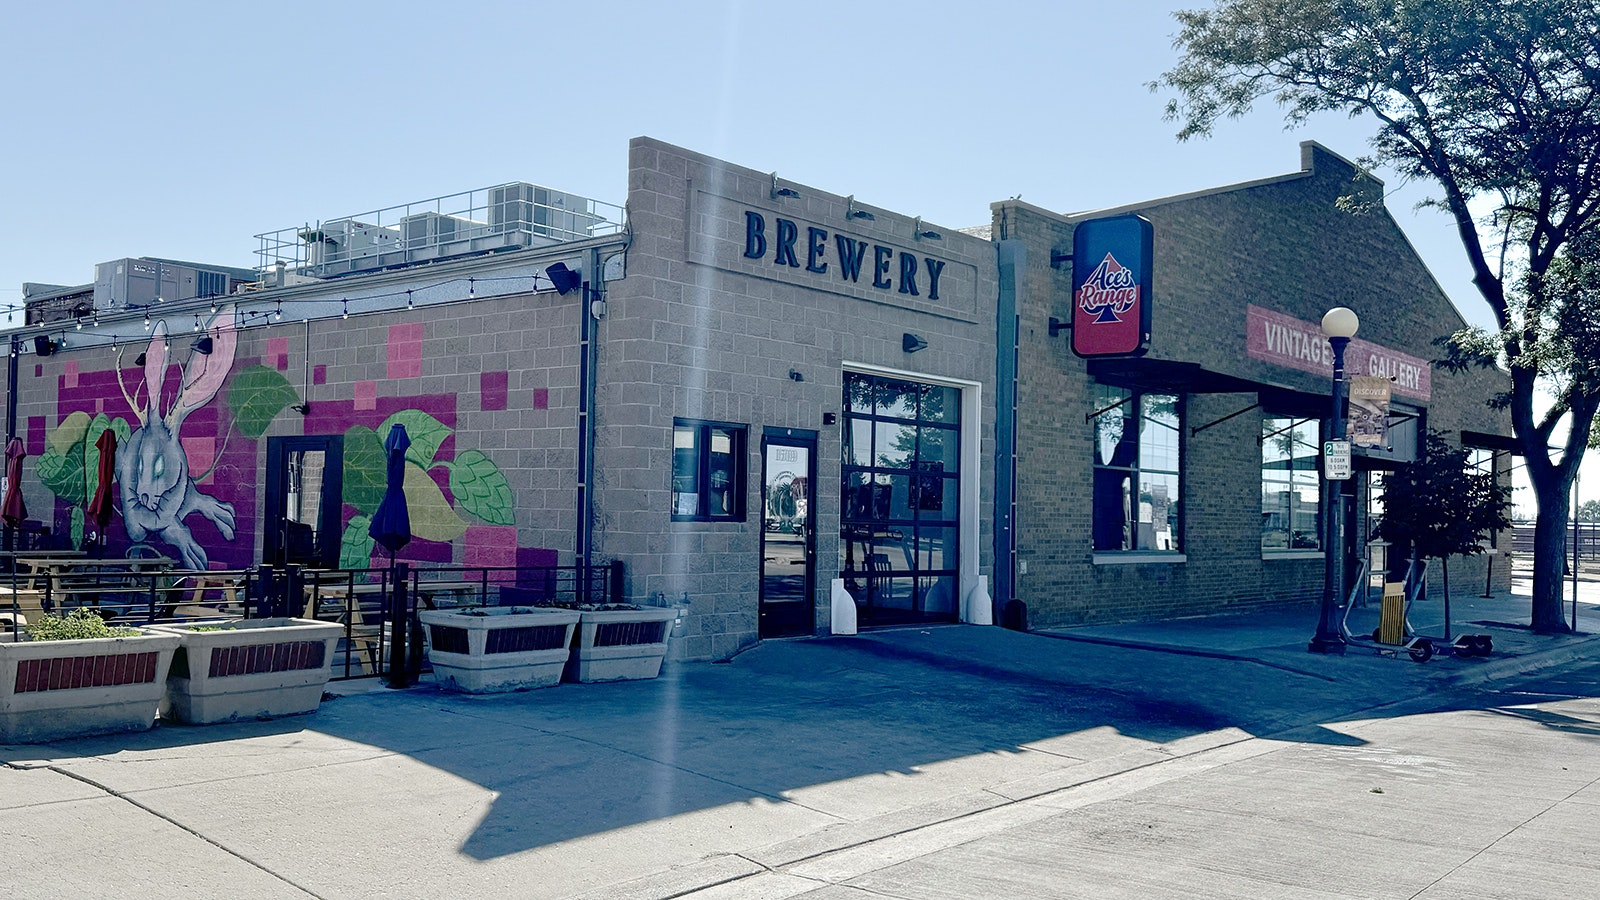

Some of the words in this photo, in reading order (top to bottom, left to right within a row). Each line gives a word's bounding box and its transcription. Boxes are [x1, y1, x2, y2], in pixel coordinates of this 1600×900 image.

[744, 210, 946, 300] BREWERY
[1088, 259, 1132, 291] Ace's
[1079, 284, 1137, 313] Range
[1264, 321, 1332, 366] VINTAGE
[1368, 354, 1421, 390] GALLERY
[1354, 388, 1387, 396] DISCOVER
[1326, 444, 1333, 455] 2
